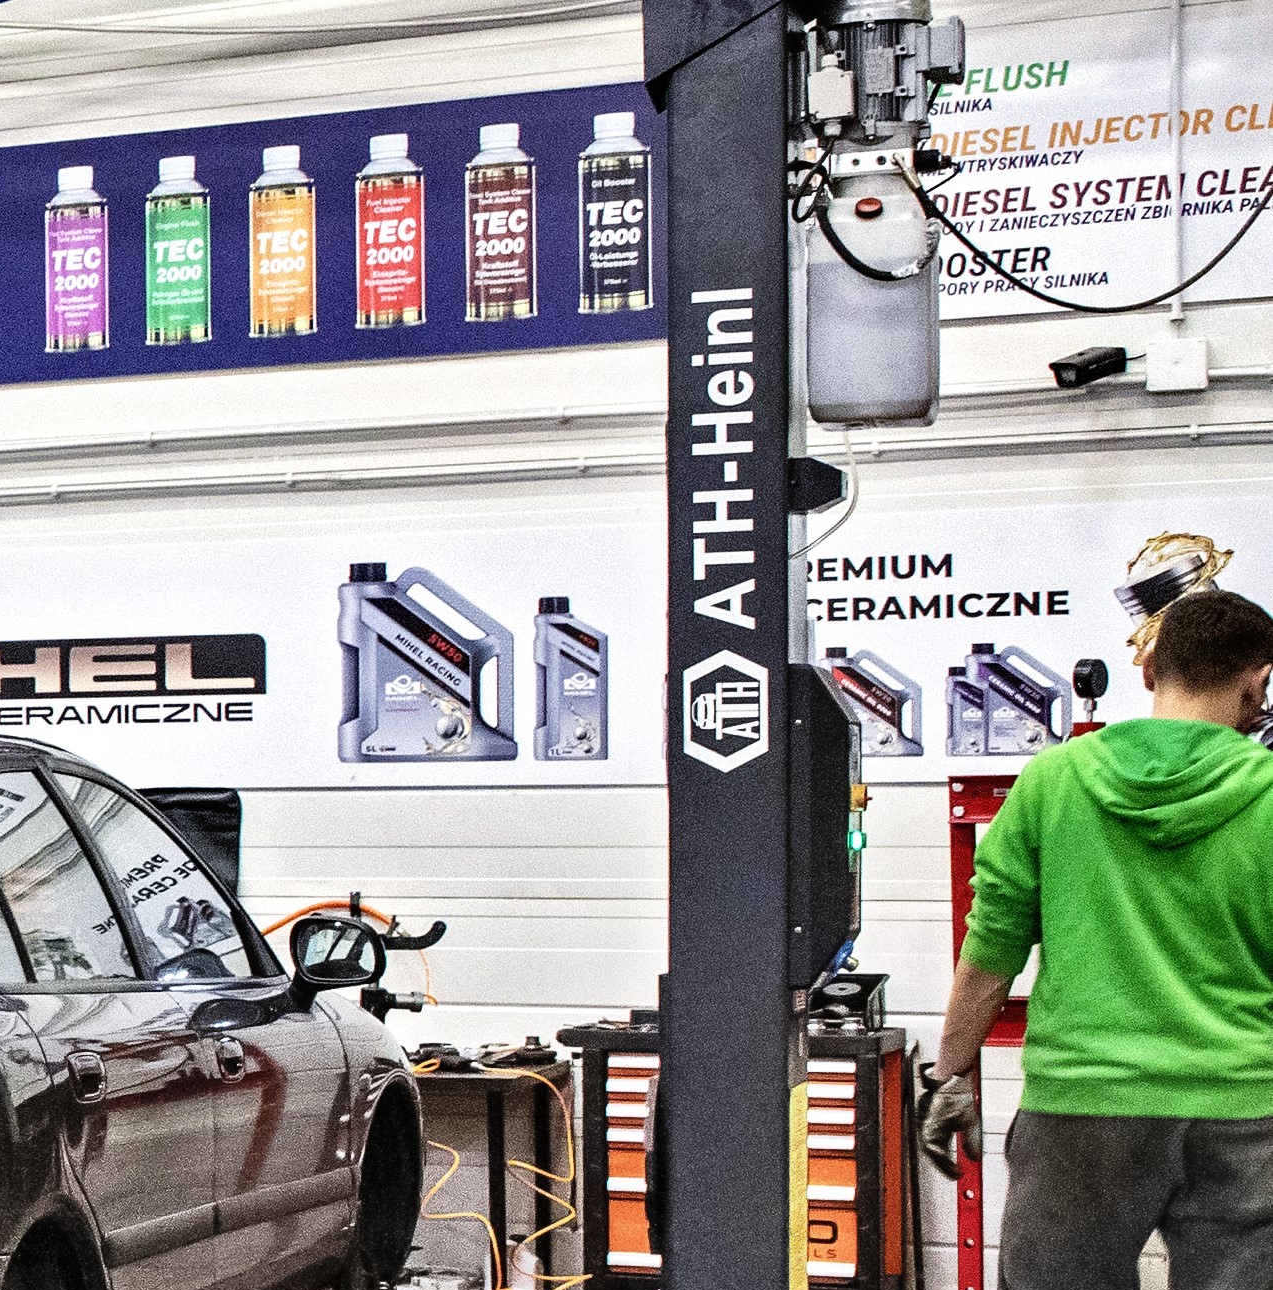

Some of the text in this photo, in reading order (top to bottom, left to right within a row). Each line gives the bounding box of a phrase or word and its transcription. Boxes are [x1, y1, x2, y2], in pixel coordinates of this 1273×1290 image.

[964, 60, 1070, 95] FLUSH
[930, 98, 993, 115] SILNIKA
[954, 150, 1084, 174] WTRYSKIWACZY
[603, 178, 636, 187] Booster
[933, 186, 1037, 218] DIESEL
[1049, 173, 1186, 211] SYSTEM
[472, 209, 528, 236] TEC
[586, 199, 644, 226] TEC
[989, 204, 1136, 232] ZANIECZYSZCZEŃ
[1141, 200, 1233, 220] ZBIRNIKA
[256, 228, 308, 255] TEC
[364, 218, 416, 244] TEC
[588, 227, 641, 247] 2000
[52, 246, 101, 272] TEC
[153, 238, 204, 263] TEC
[366, 245, 414, 265] 2000
[475, 237, 525, 257] 2000
[156, 264, 202, 283] 2000
[259, 256, 305, 275] 2000
[938, 246, 1051, 278] OSTER
[55, 272, 99, 292] 2000
[1044, 272, 1109, 289] SILNIKA
[691, 288, 755, 631] ATH-Heinl
[394, 632, 462, 688] MIHEL RACING
